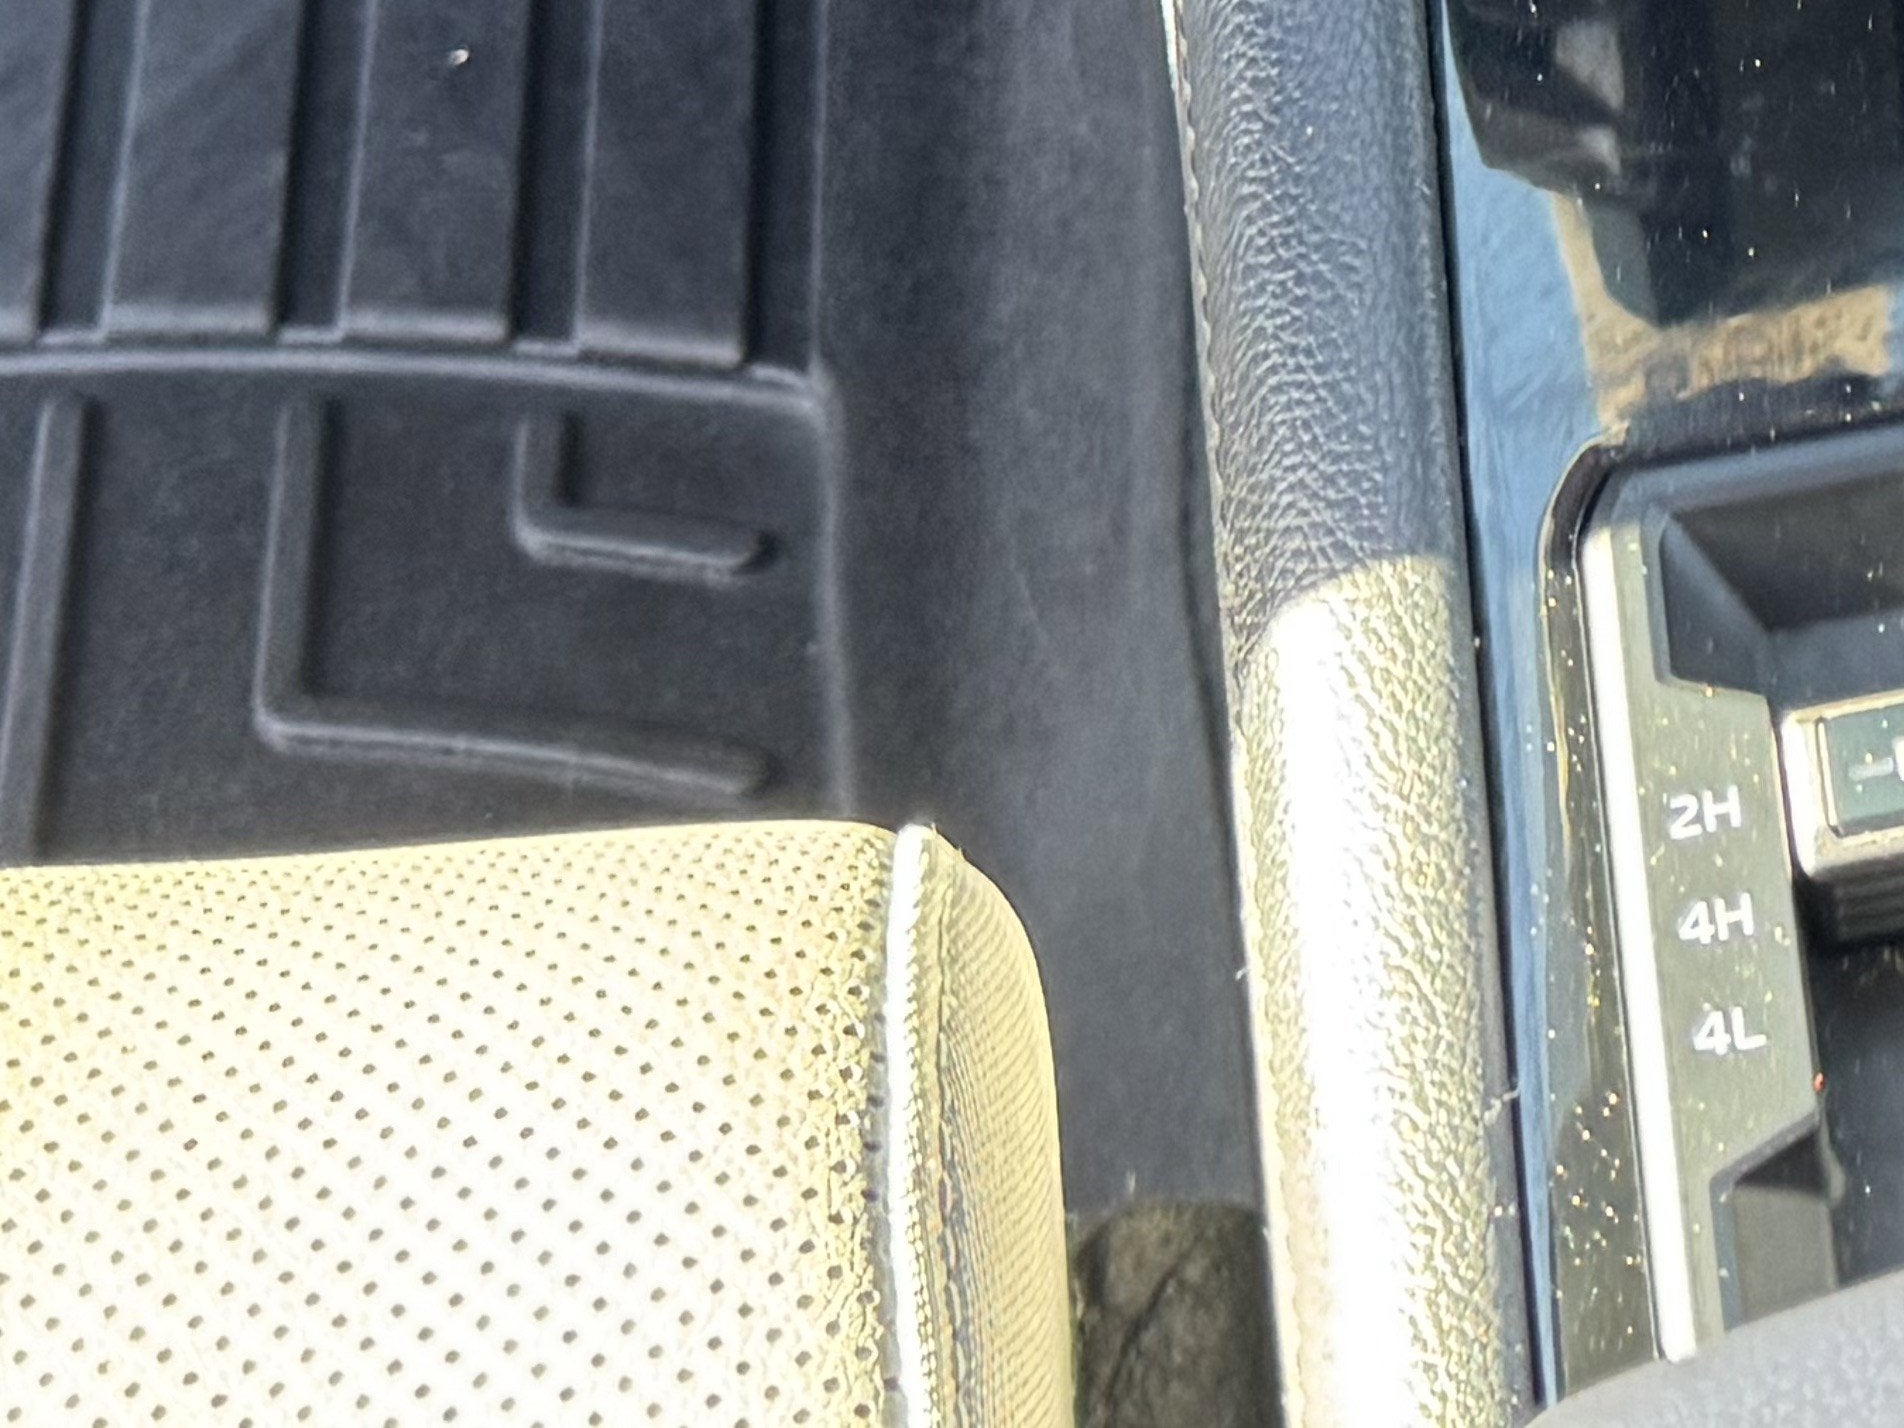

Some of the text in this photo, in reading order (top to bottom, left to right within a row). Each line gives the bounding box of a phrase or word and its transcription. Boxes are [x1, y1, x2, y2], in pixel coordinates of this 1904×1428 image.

[1667, 784, 1742, 840] 2H
[1677, 892, 1755, 945] 4H
[1692, 1005, 1768, 1056] 4L
